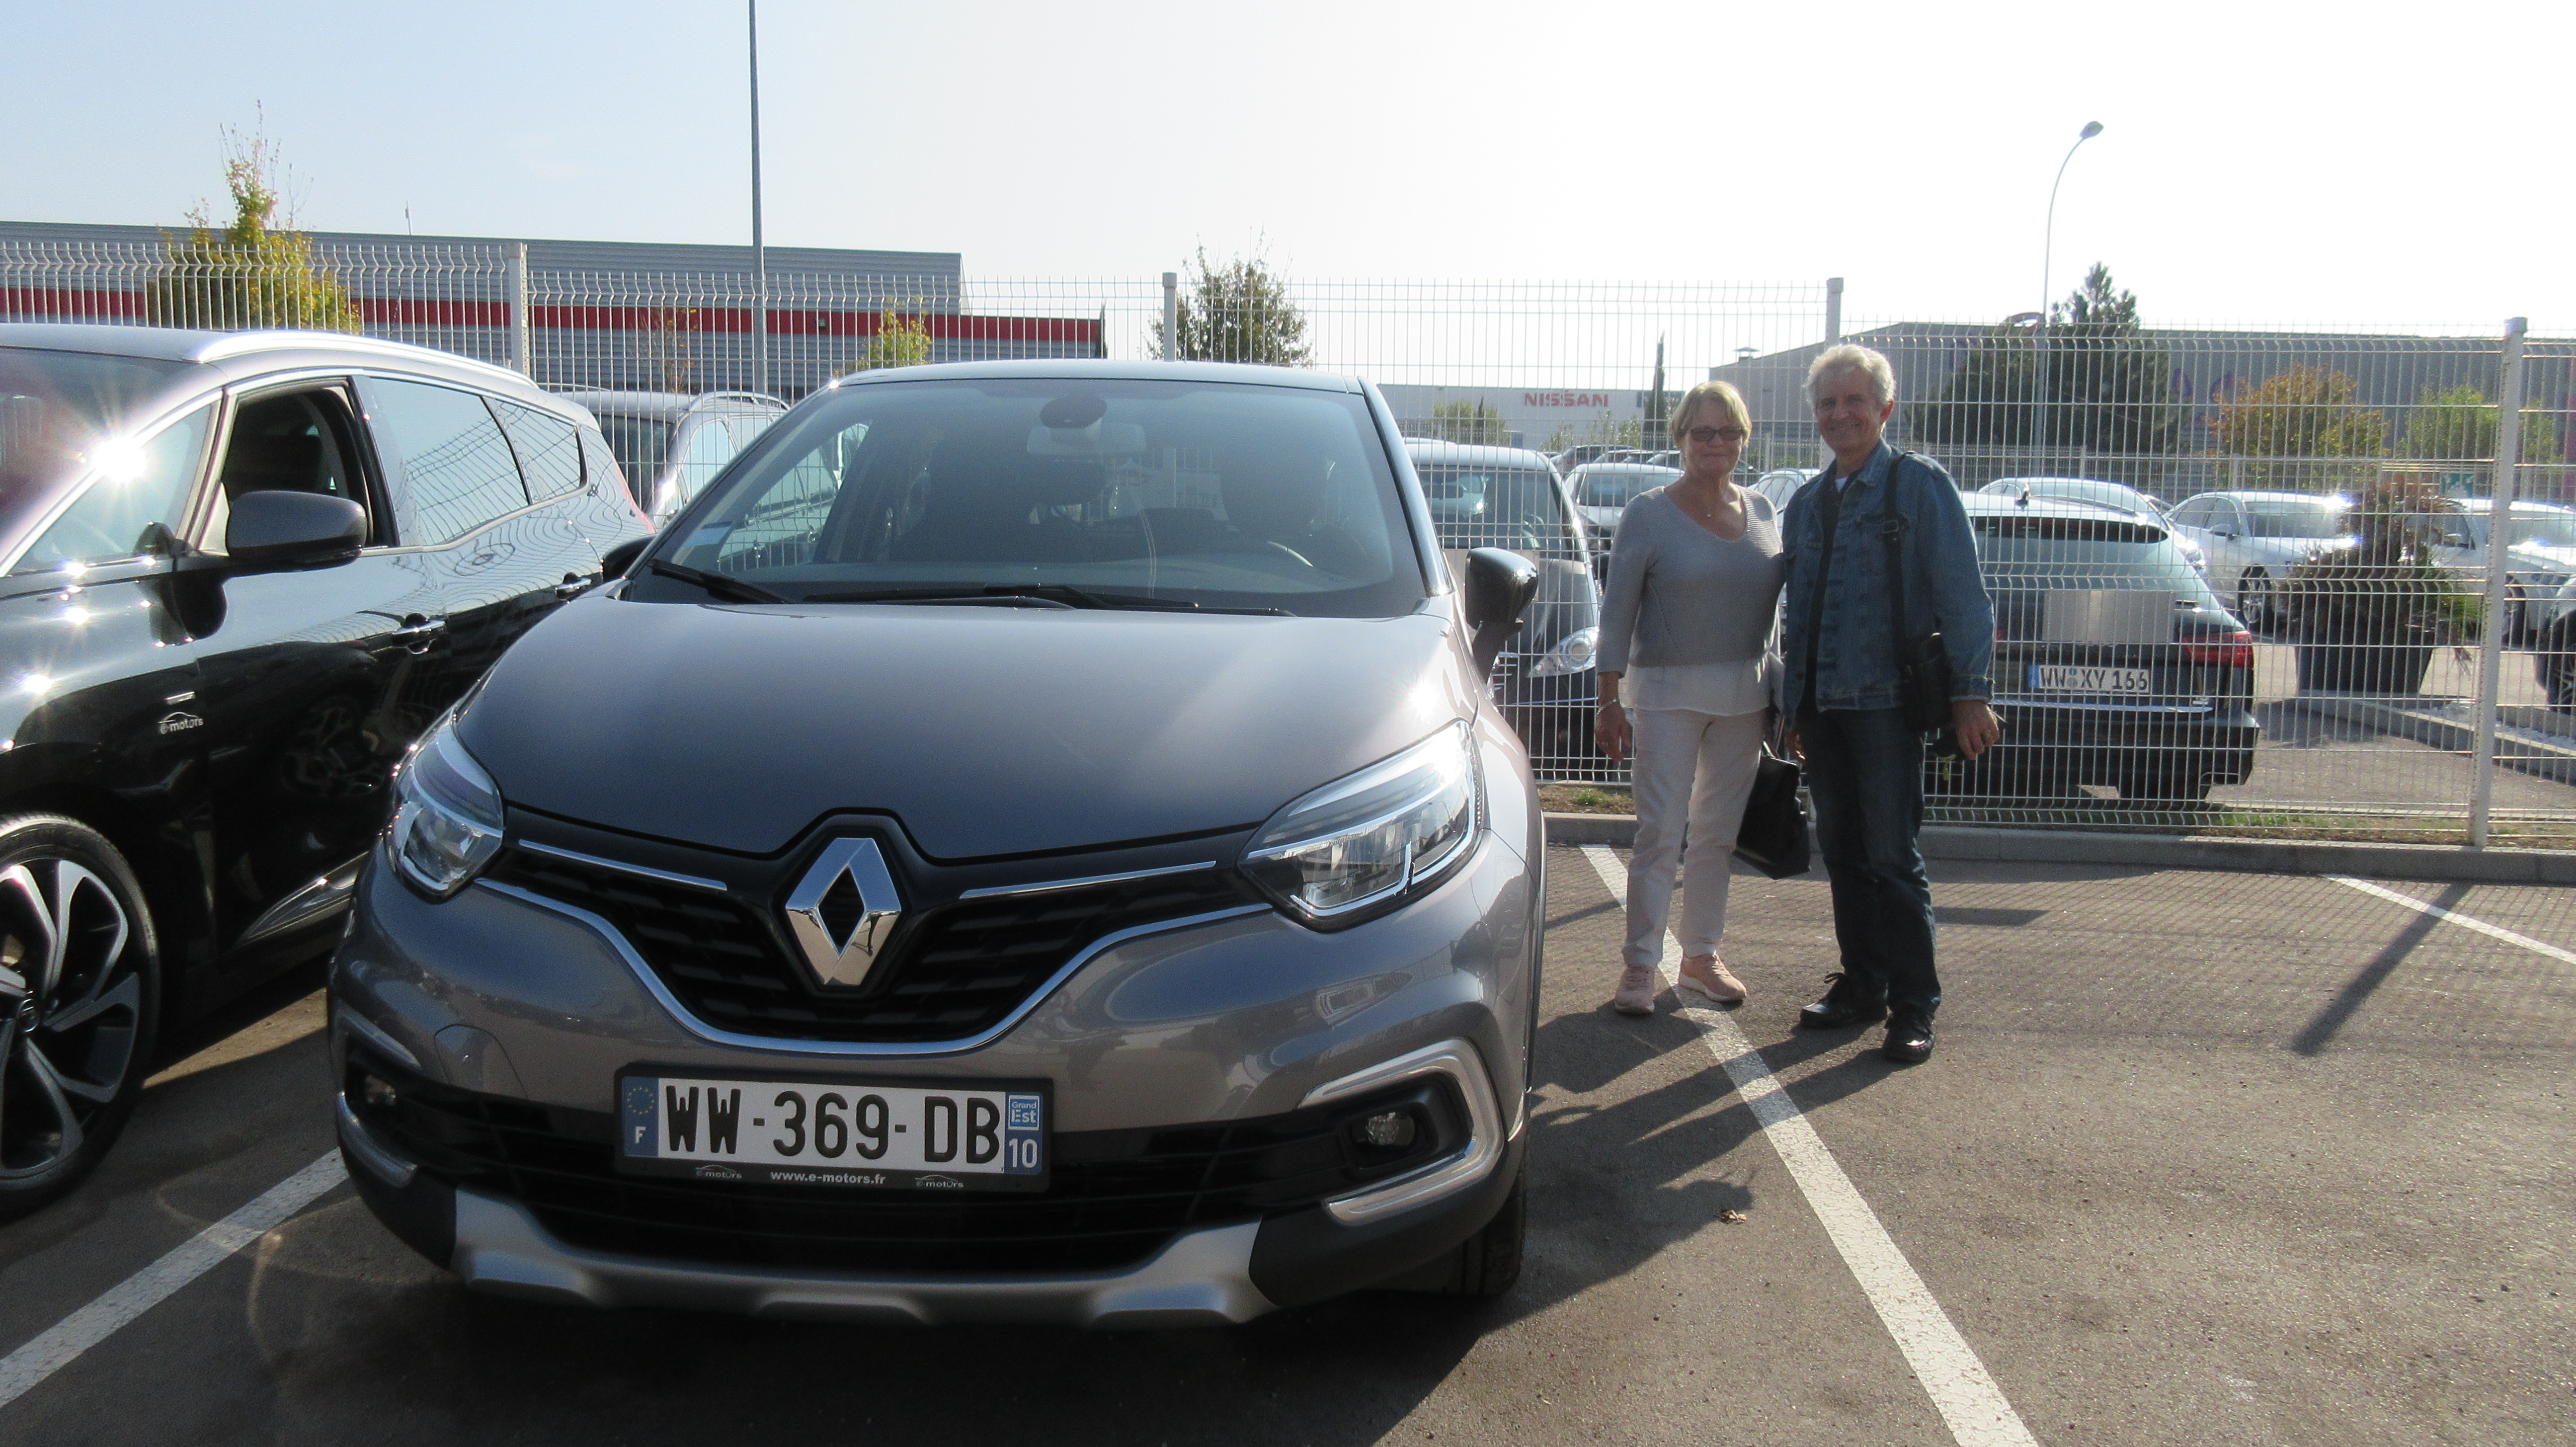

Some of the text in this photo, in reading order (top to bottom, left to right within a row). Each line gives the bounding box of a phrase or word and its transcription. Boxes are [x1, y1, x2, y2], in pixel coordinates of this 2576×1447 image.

[1524, 392, 1609, 407] NISSAN
[2081, 669, 2106, 689] XY
[2112, 670, 2148, 691] 166
[666, 1085, 1000, 1164] WW-369-DB
[1011, 1109, 1037, 1124] Est
[635, 1125, 646, 1144] F
[1009, 1138, 1038, 1168] 10
[770, 1172, 886, 1184] www.e-motors.fr
